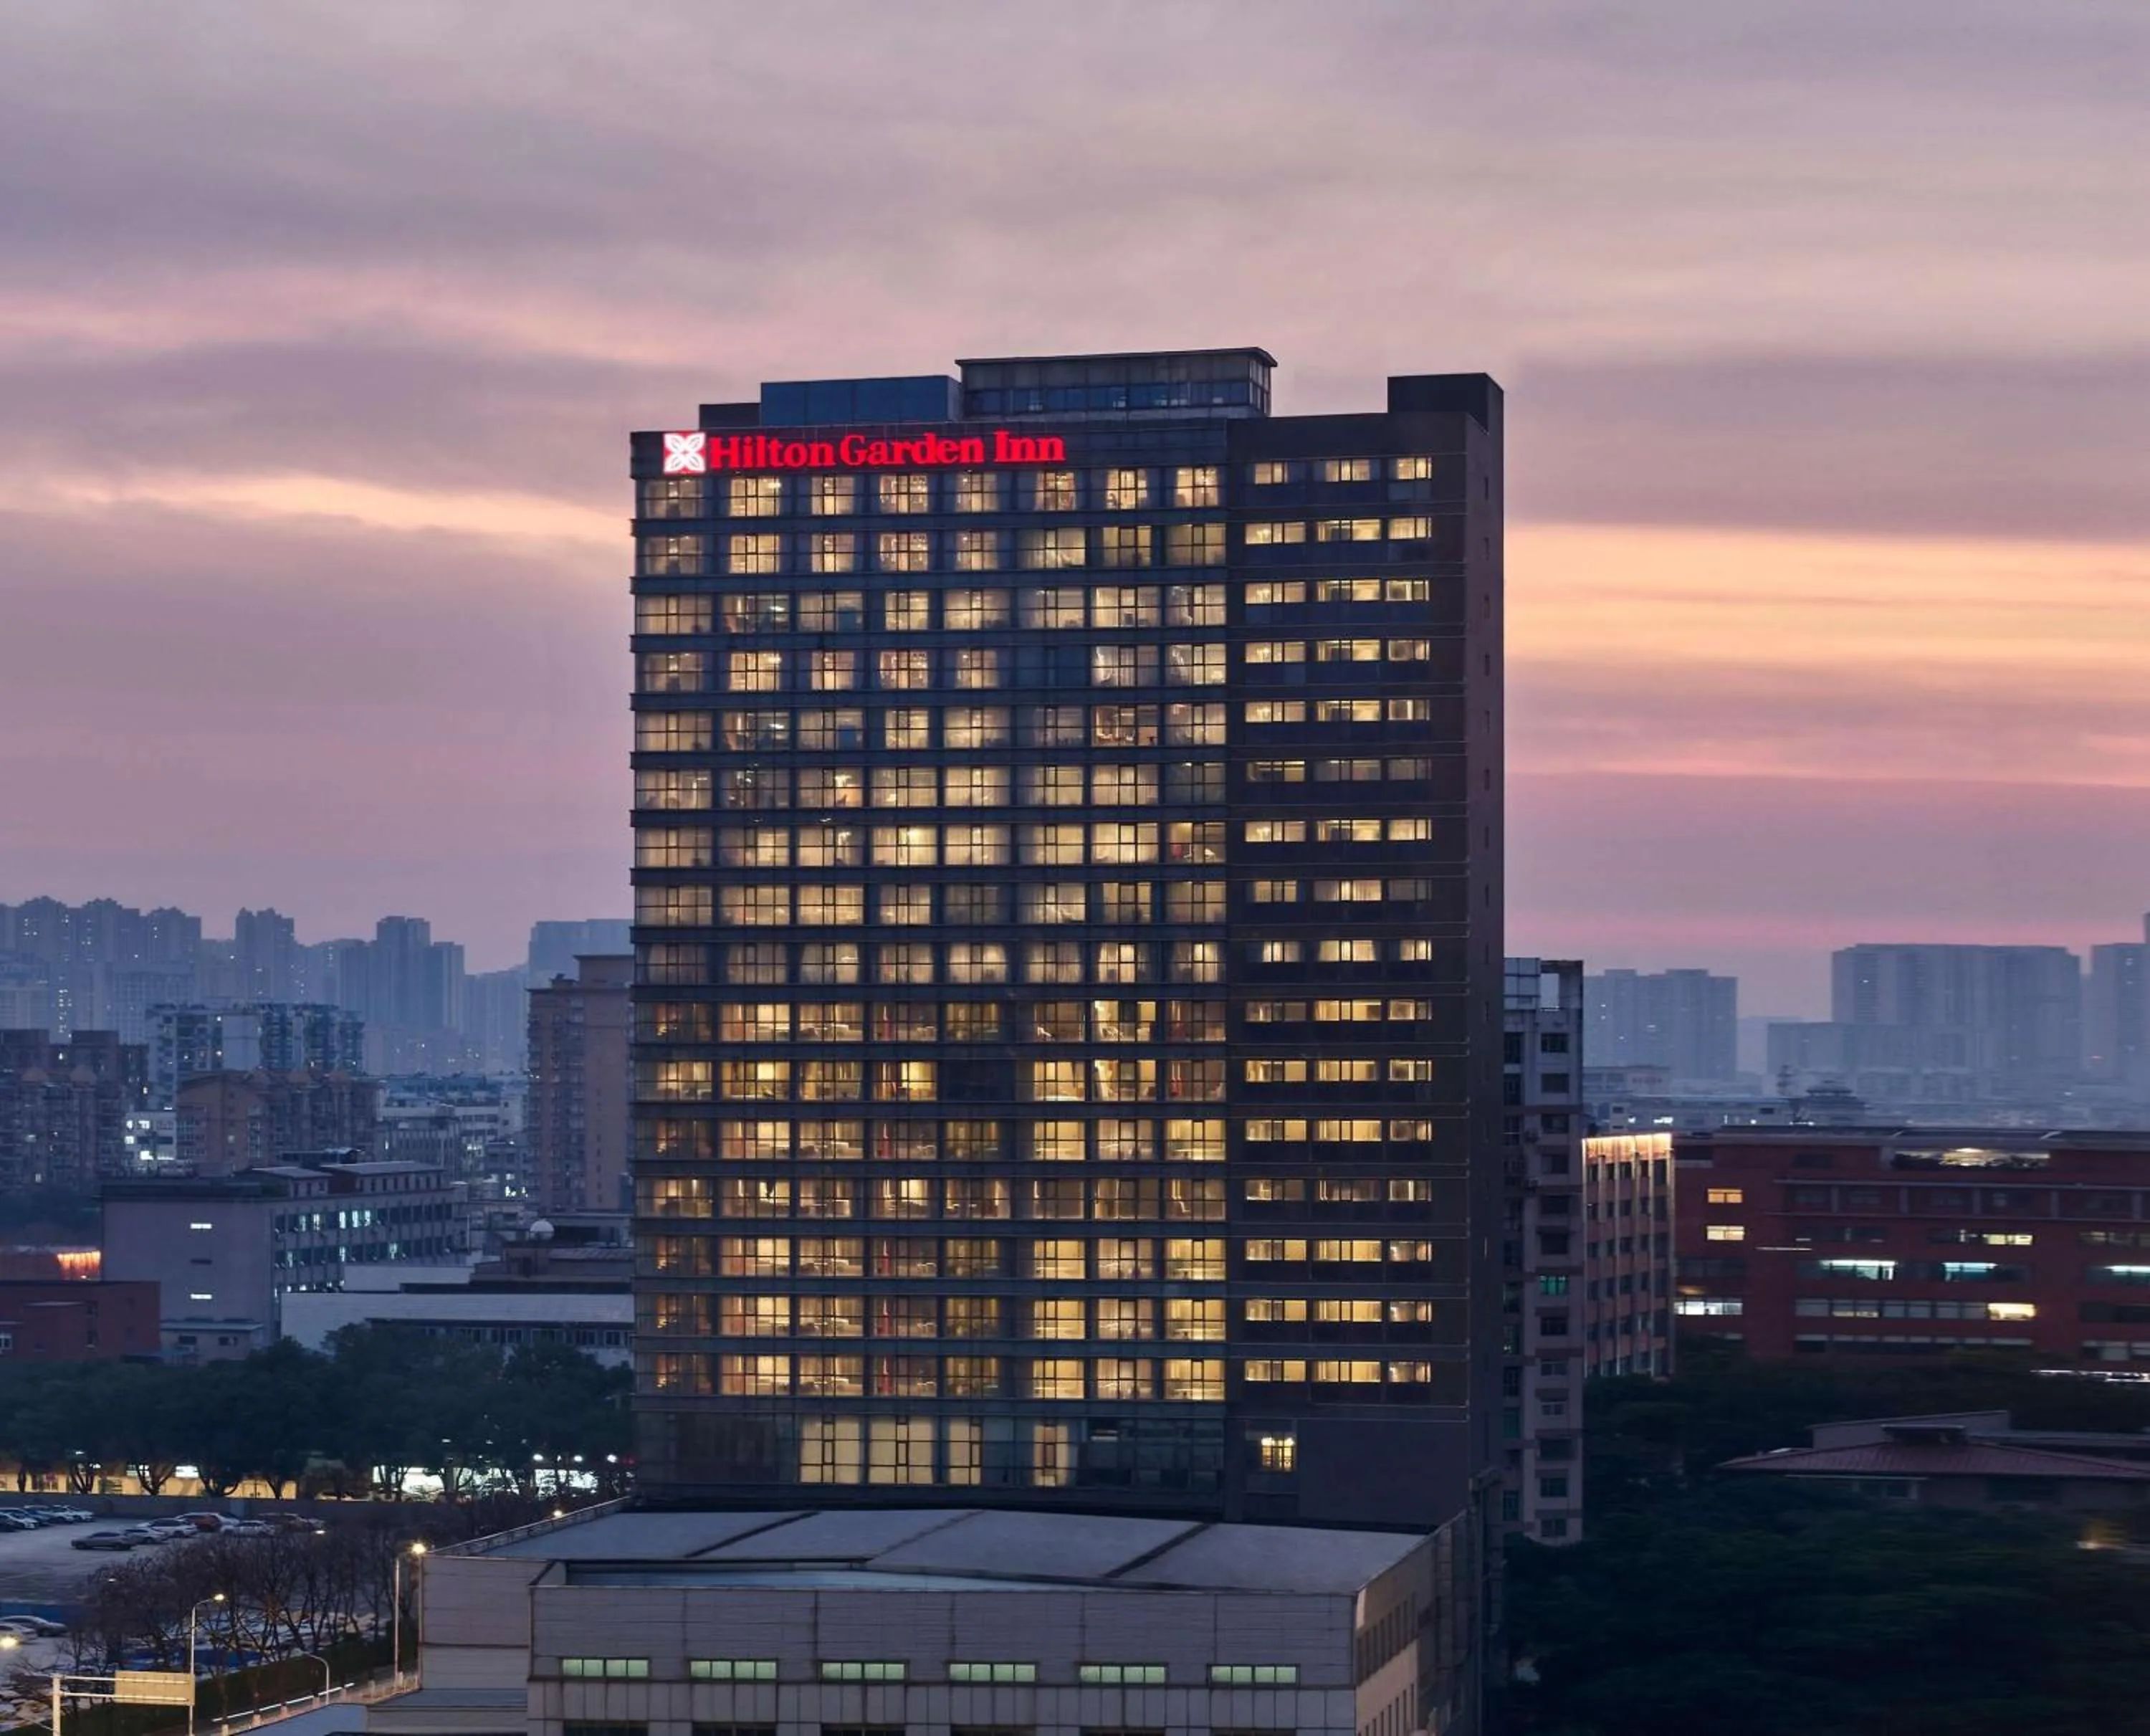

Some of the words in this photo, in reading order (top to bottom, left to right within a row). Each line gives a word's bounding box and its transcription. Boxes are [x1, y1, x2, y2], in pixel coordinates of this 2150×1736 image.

[708, 434, 836, 469] Hilton
[839, 432, 985, 466] Garden
[993, 429, 1066, 463] Inn
